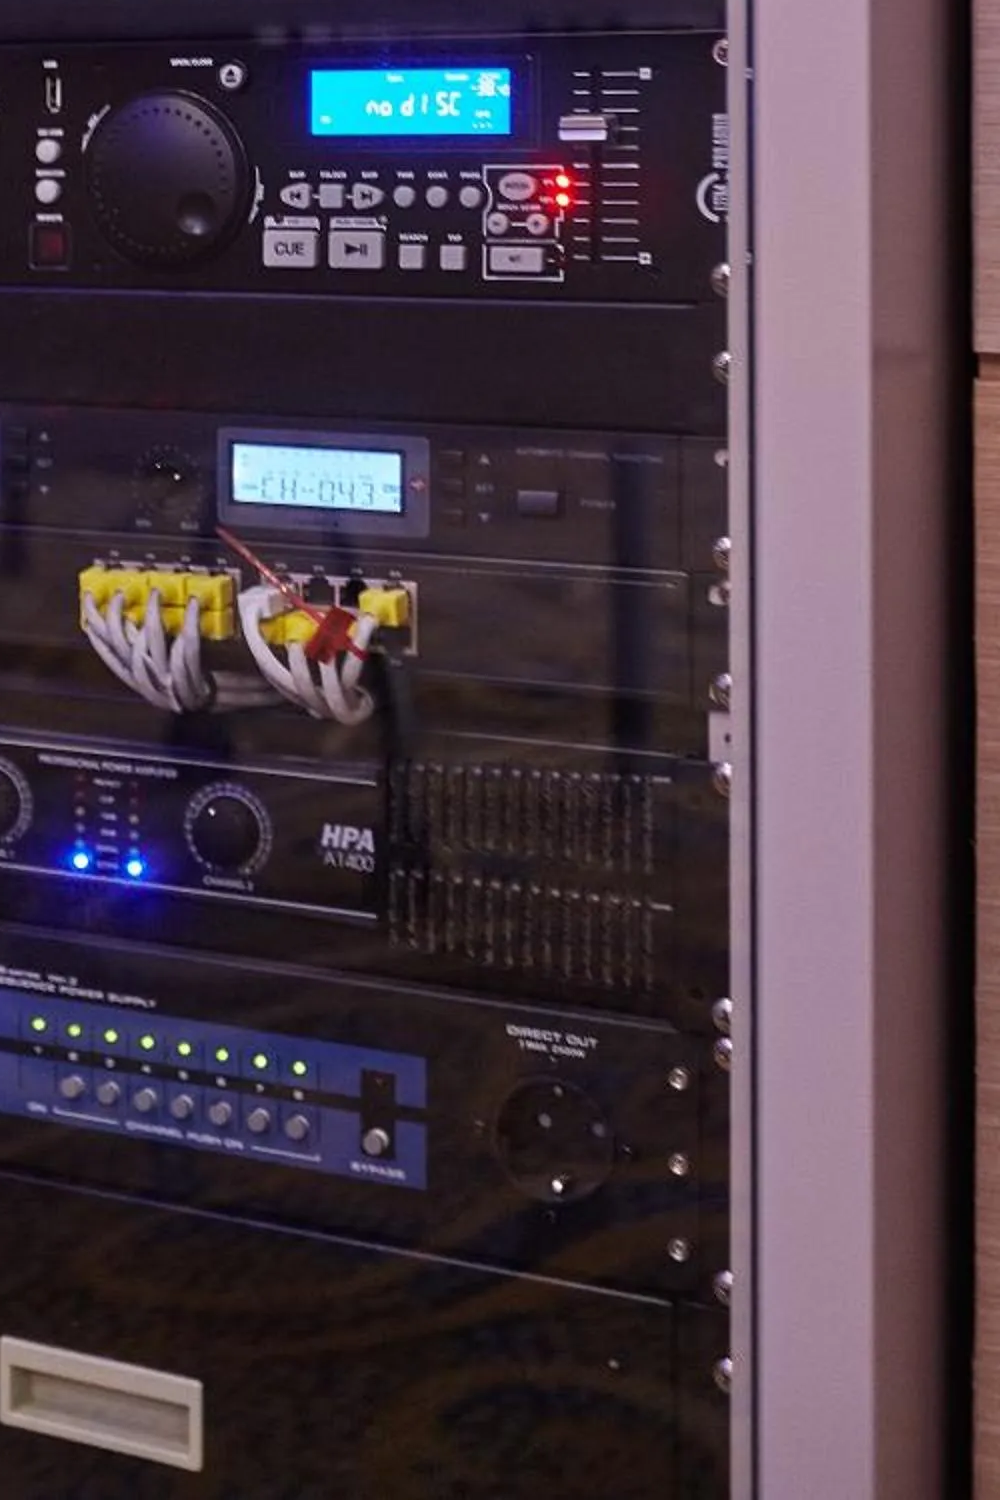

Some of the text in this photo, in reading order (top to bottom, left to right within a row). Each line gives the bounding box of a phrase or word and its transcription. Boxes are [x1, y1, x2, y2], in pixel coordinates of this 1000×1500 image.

[273, 241, 304, 256] CUE
[321, 823, 375, 853] HPA
[59, 985, 105, 1000] POWER
[505, 1023, 599, 1050] DIRECT OUT
